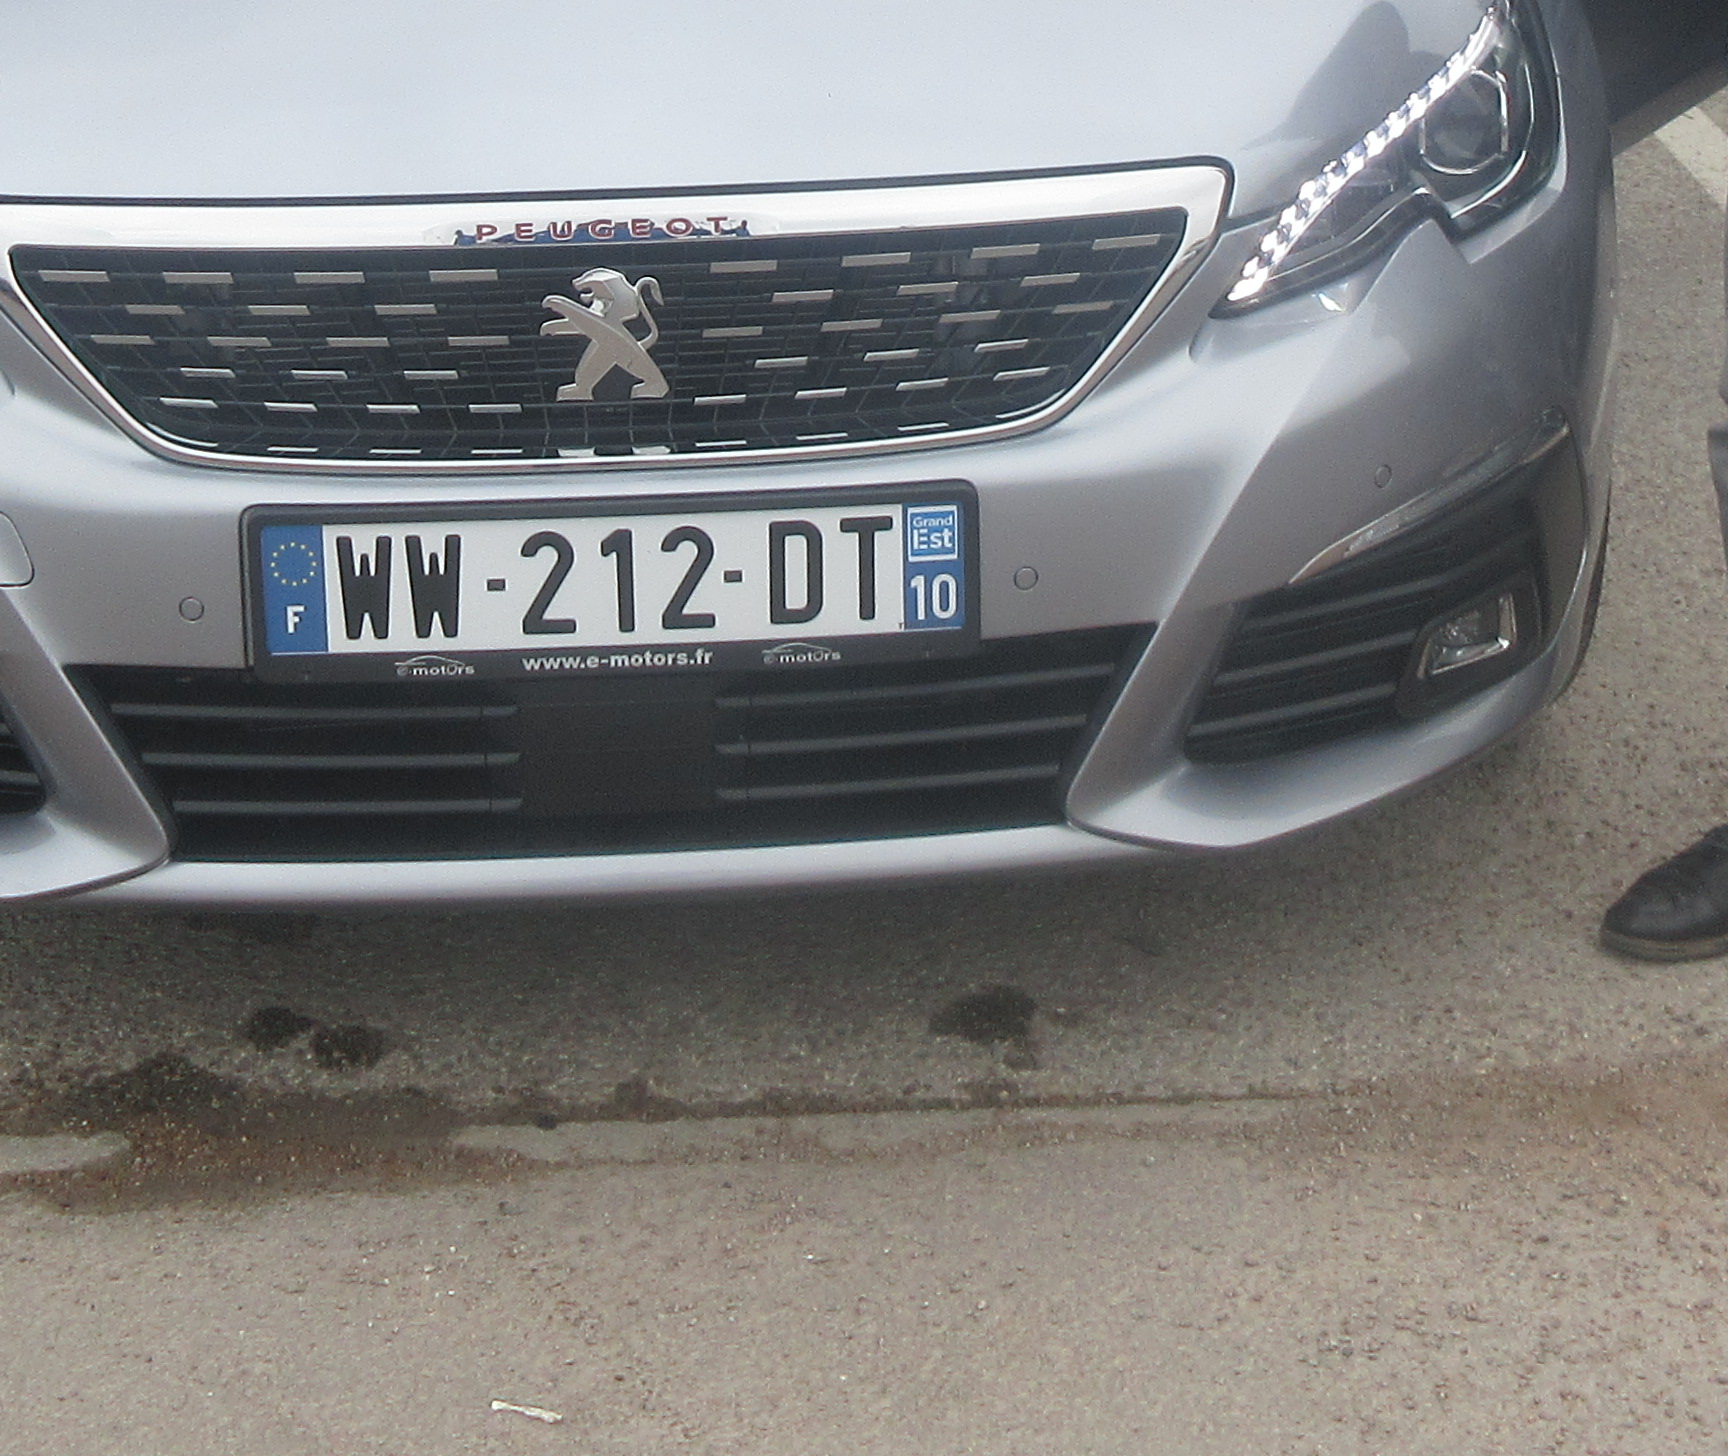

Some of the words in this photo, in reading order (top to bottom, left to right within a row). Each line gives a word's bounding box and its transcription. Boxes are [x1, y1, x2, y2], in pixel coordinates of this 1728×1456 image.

[475, 216, 729, 242] PEUGEOT
[913, 514, 952, 527] Grand
[913, 528, 952, 550] Est
[335, 515, 894, 640] WW-212-DT
[910, 573, 957, 620] 10
[286, 605, 305, 634] F
[522, 647, 714, 671] www.e-motors.fr
